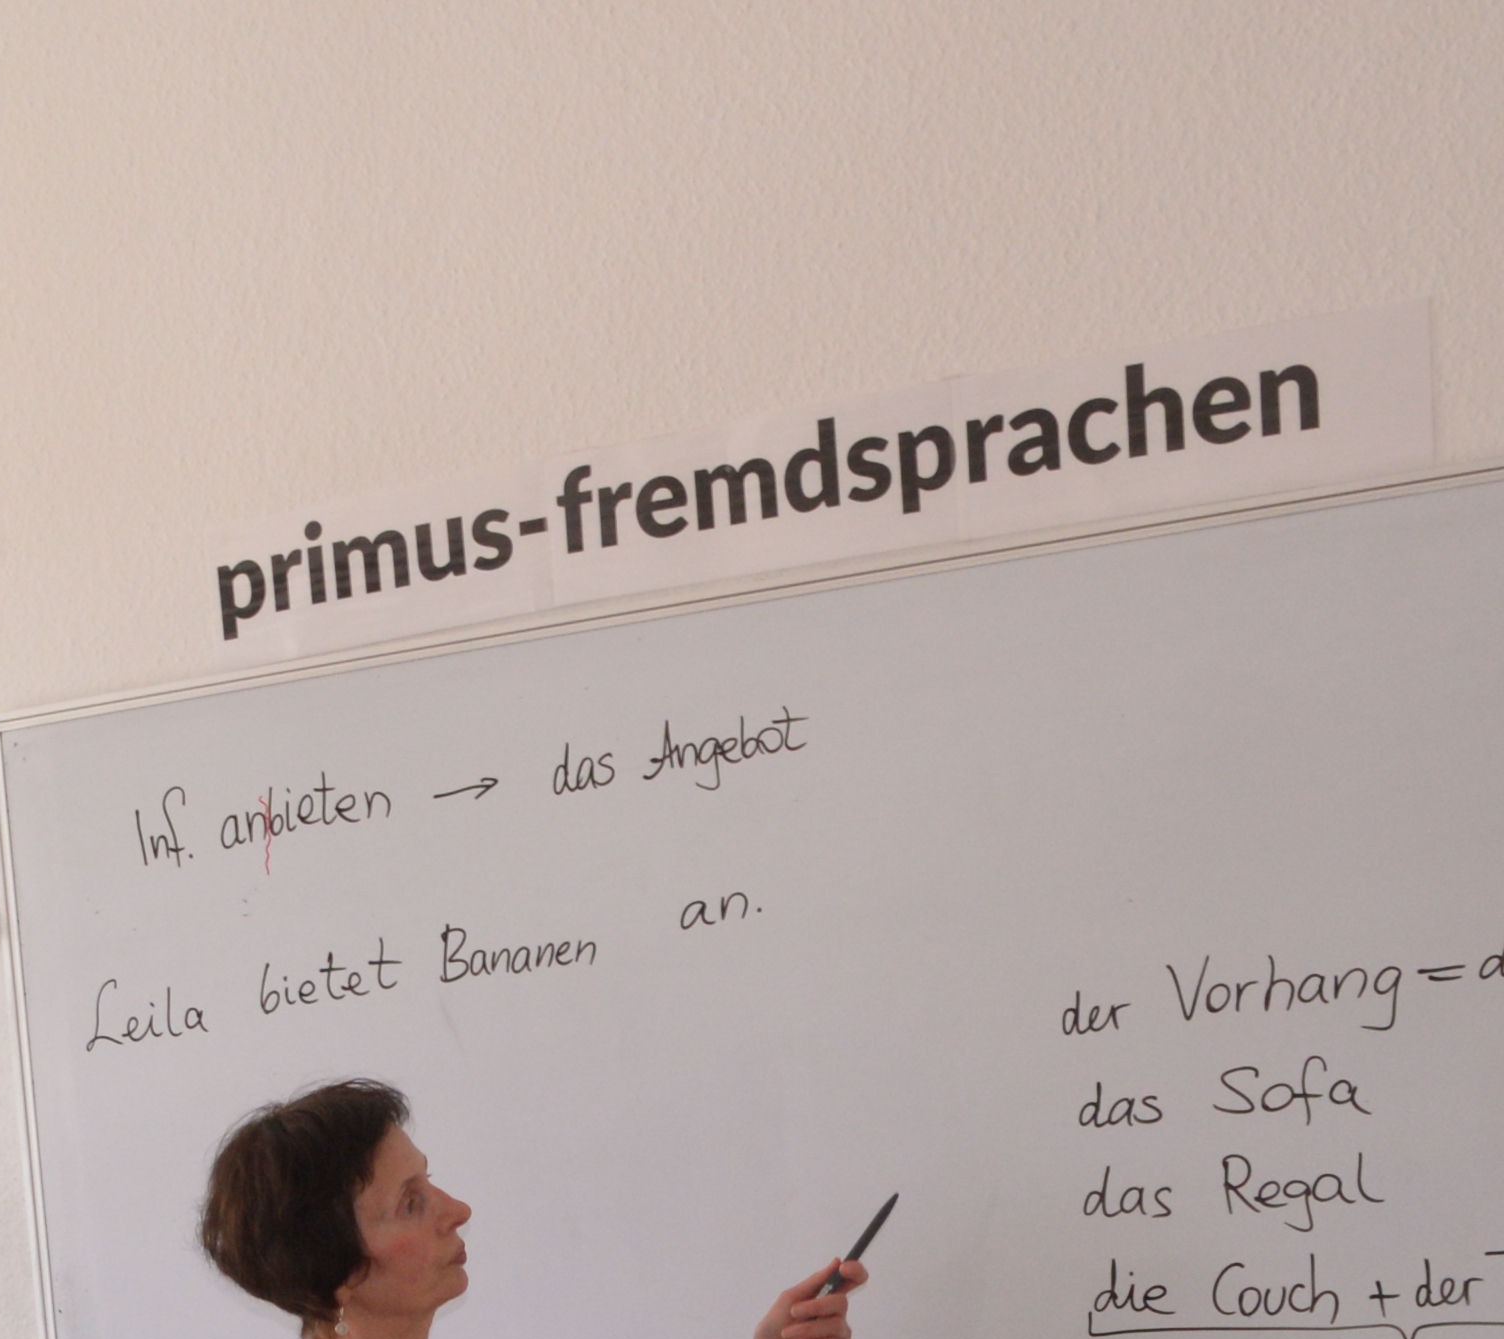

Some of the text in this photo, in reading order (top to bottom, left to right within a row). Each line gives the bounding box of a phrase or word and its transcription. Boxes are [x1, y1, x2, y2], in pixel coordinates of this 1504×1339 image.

[215, 362, 1323, 642] primus-fremdsprachen
[220, 770, 393, 851] anbieten
[552, 742, 616, 795] das
[642, 705, 810, 791] Angebot
[85, 978, 210, 1053] Leila
[259, 936, 404, 1015] bietet
[439, 923, 598, 984] Bananen
[1061, 989, 1132, 1036] der
[1077, 1054, 1373, 1128] das Sofa
[1082, 1151, 1386, 1233] das Regal
[1092, 1257, 1177, 1315] die
[1211, 1252, 1341, 1325] Couch
[1414, 1257, 1485, 1308] der
